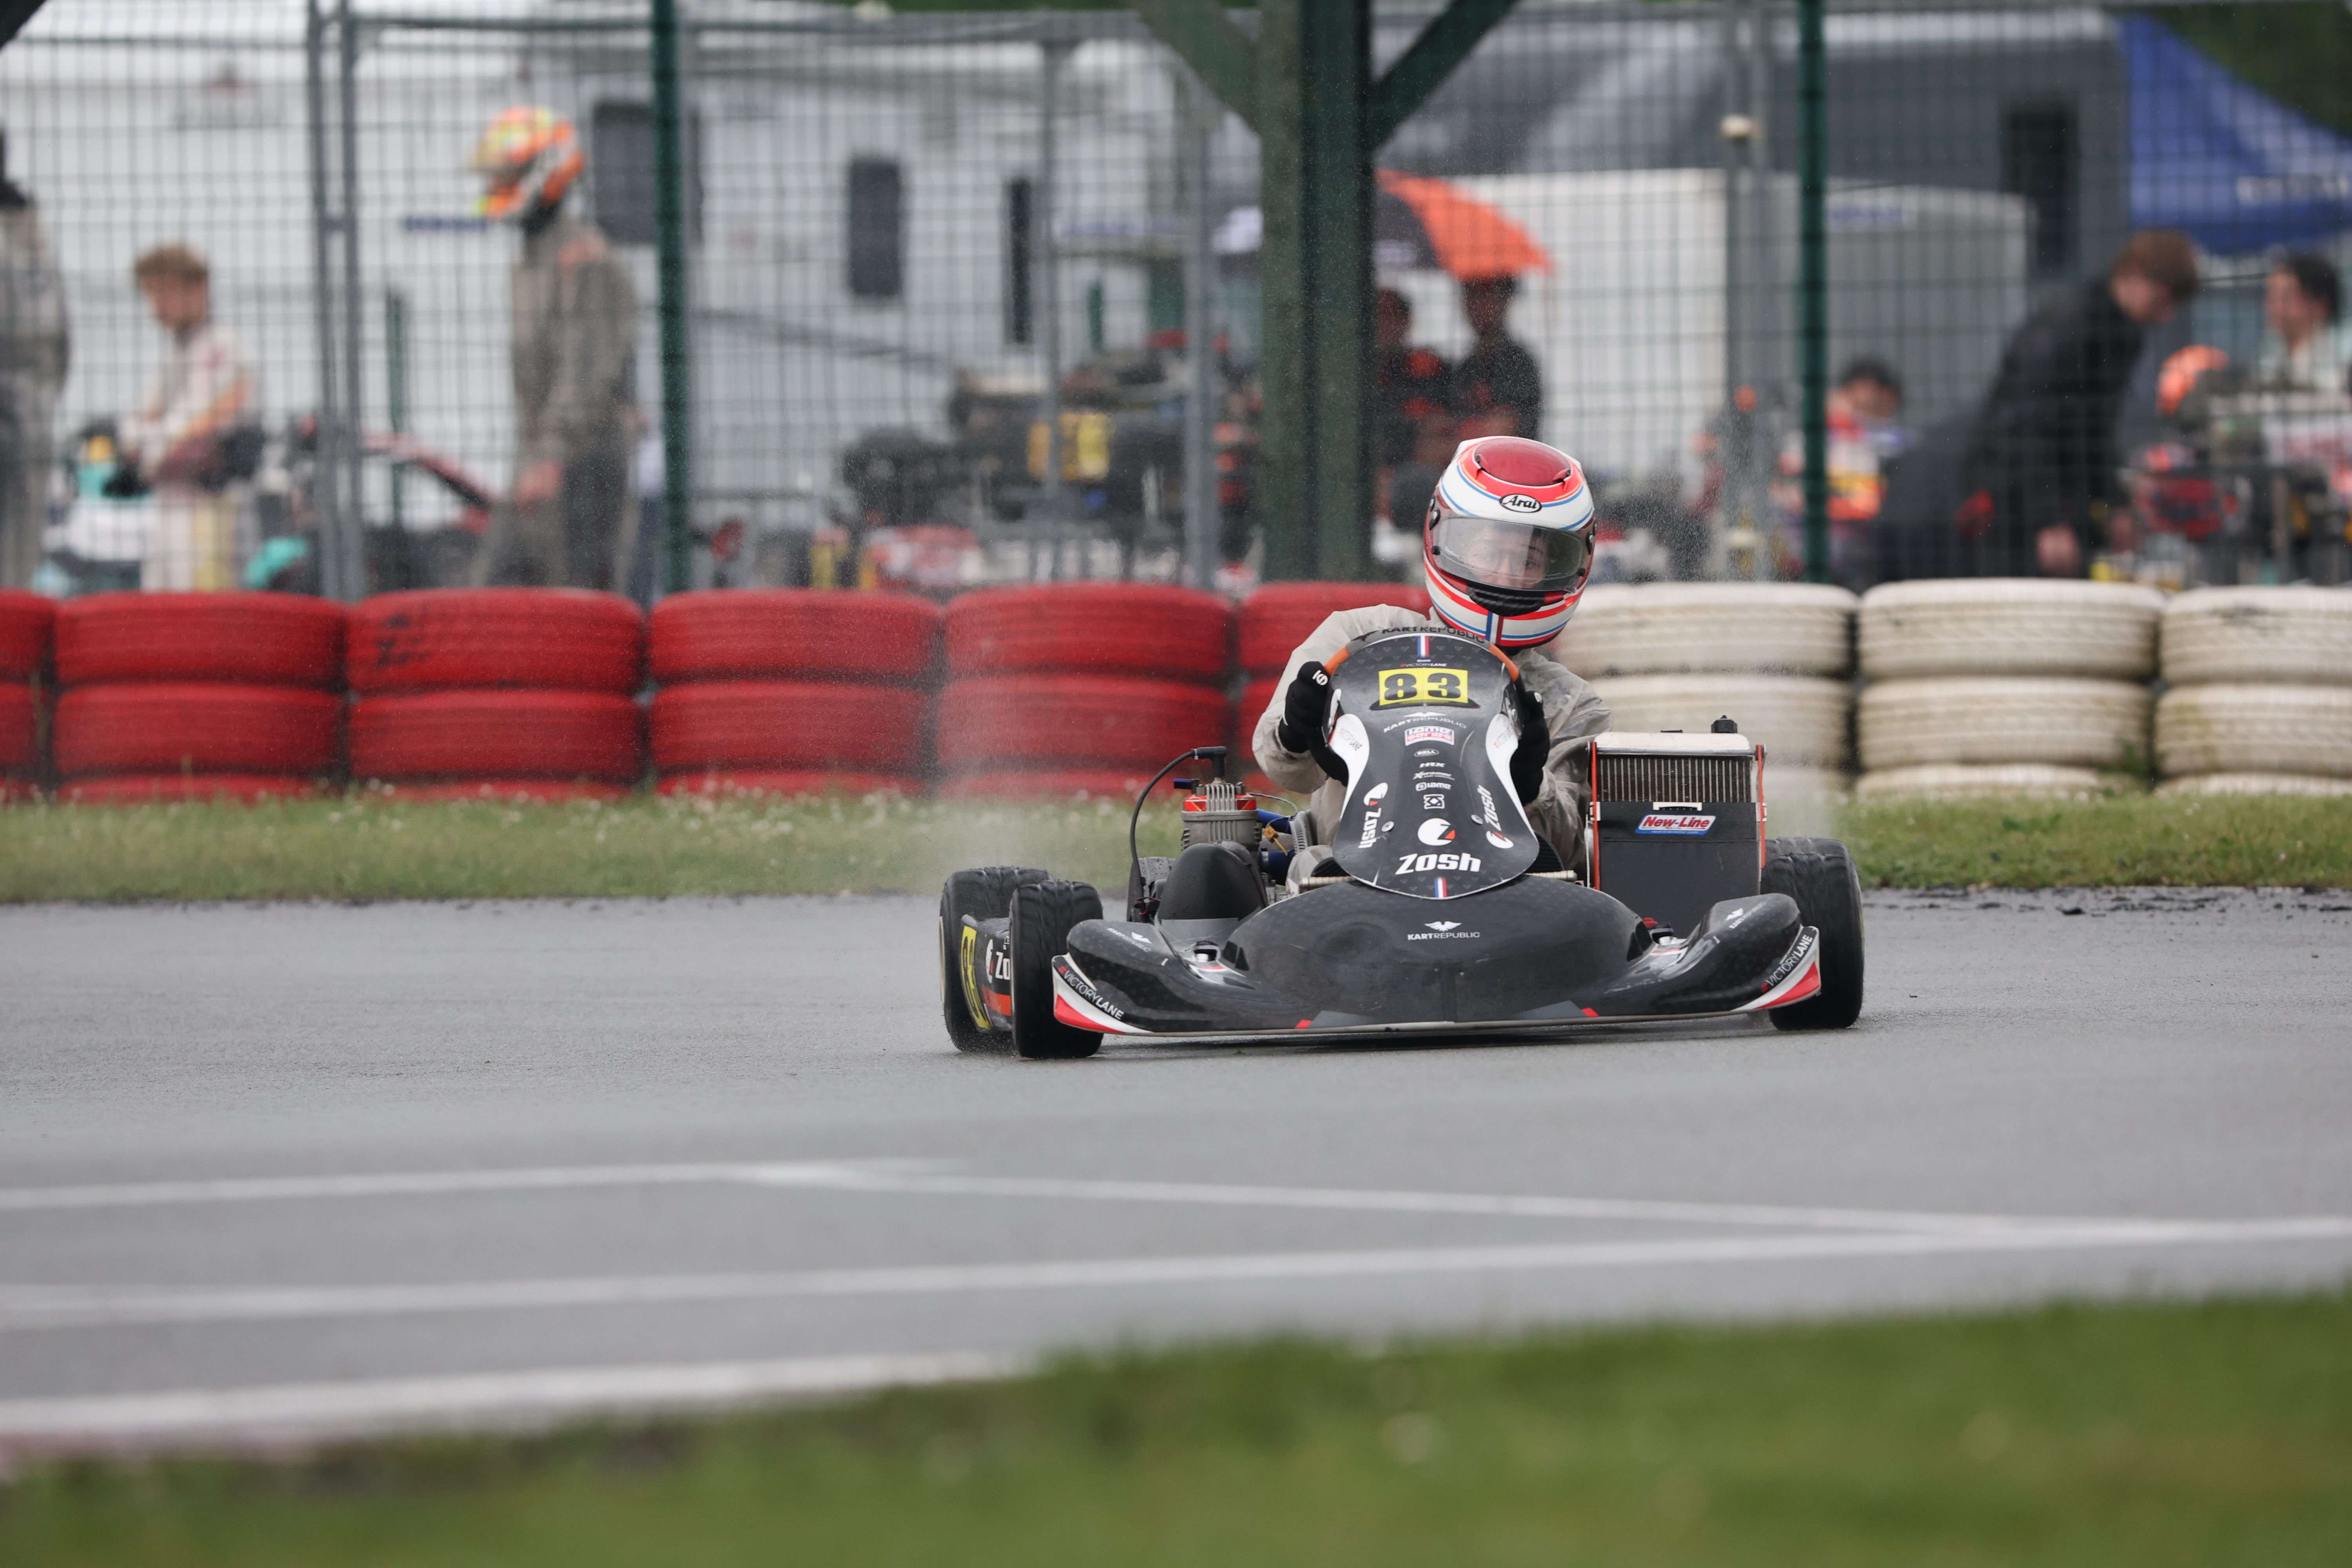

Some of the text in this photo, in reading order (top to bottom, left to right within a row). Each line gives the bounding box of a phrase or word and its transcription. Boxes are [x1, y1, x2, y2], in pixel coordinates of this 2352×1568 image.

[1502, 495, 1539, 509] Arai
[1382, 626, 1485, 643] KARTREPUBLIC
[1385, 673, 1461, 701] 83
[1383, 717, 1467, 733] KARTREPUBLIC
[1642, 816, 1710, 828] New-Line
[1407, 932, 1481, 940] KARTREPUBLIC
[1057, 965, 1124, 1020] #VICTORYLANE
